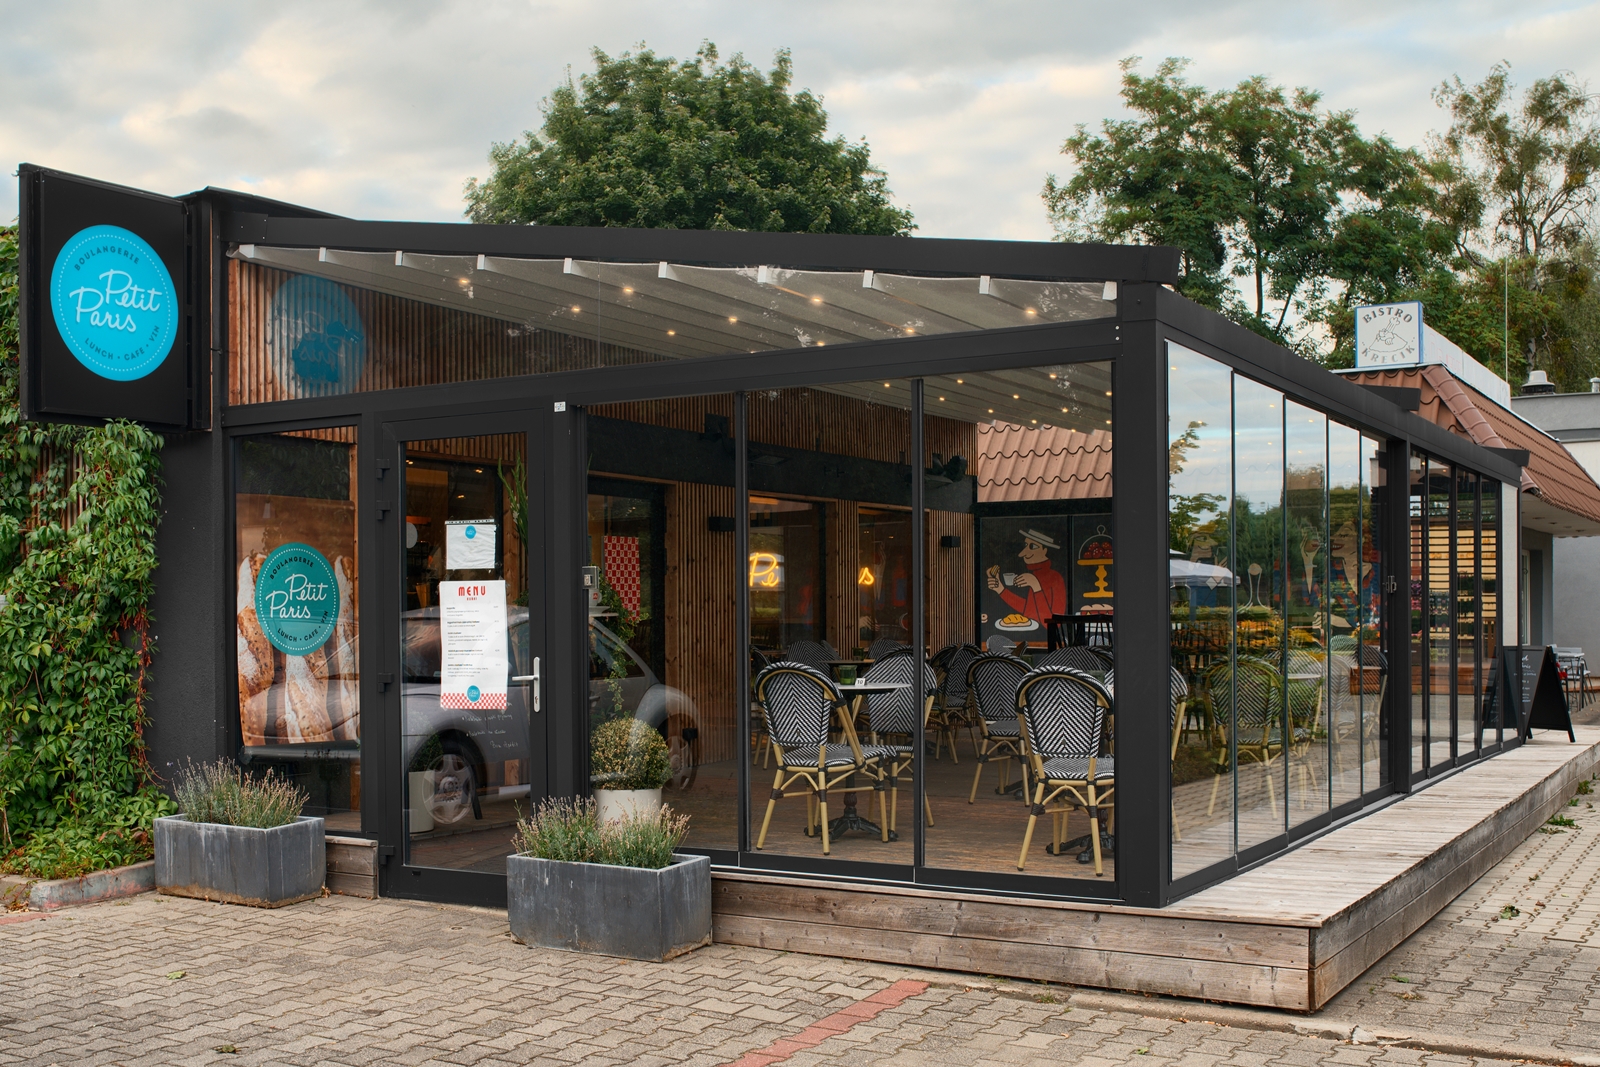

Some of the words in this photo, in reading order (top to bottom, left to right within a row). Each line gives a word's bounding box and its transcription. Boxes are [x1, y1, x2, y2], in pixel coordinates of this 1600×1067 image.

[74, 245, 140, 271] BOULANGERIE
[98, 268, 163, 312] Petit
[69, 286, 137, 333] Paris
[1362, 306, 1413, 324] BISTRO
[84, 337, 114, 361] LUNCH
[149, 324, 161, 342] VIN
[1361, 345, 1415, 364] KRECIK
[270, 556, 314, 580] BOULANGERIE
[284, 573, 329, 601] Petit
[458, 585, 486, 597] MENU
[265, 590, 311, 619] Paris
[277, 628, 298, 643] LUNCH
[320, 610, 329, 624] VIN
